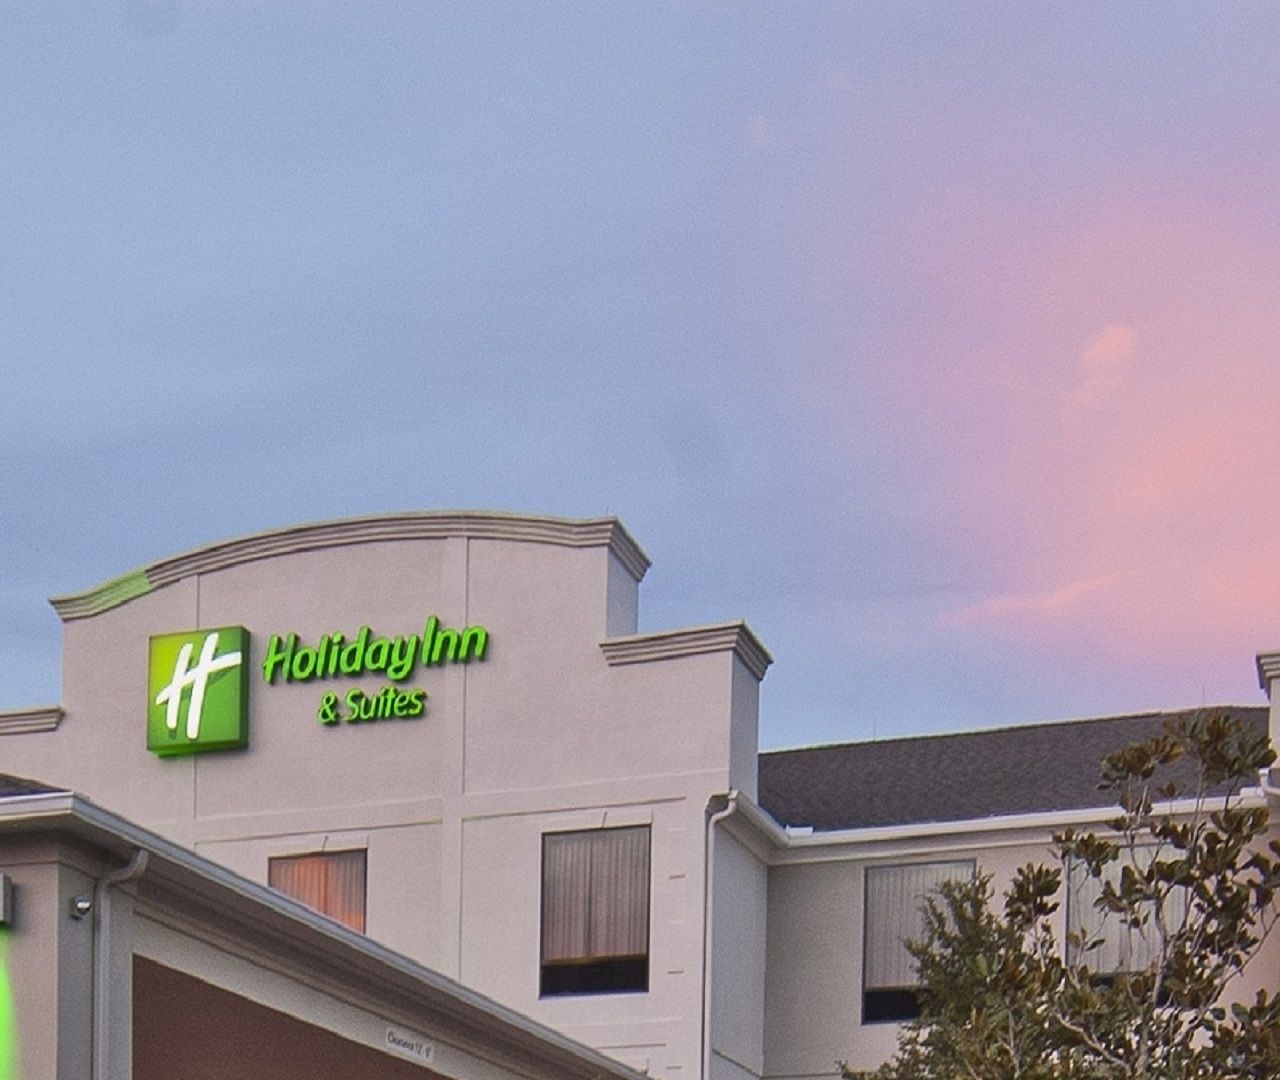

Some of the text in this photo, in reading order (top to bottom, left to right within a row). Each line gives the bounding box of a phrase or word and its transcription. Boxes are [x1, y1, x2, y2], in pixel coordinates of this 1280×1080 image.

[263, 615, 488, 684] Holiday Inn
[317, 686, 426, 725] & Suites
